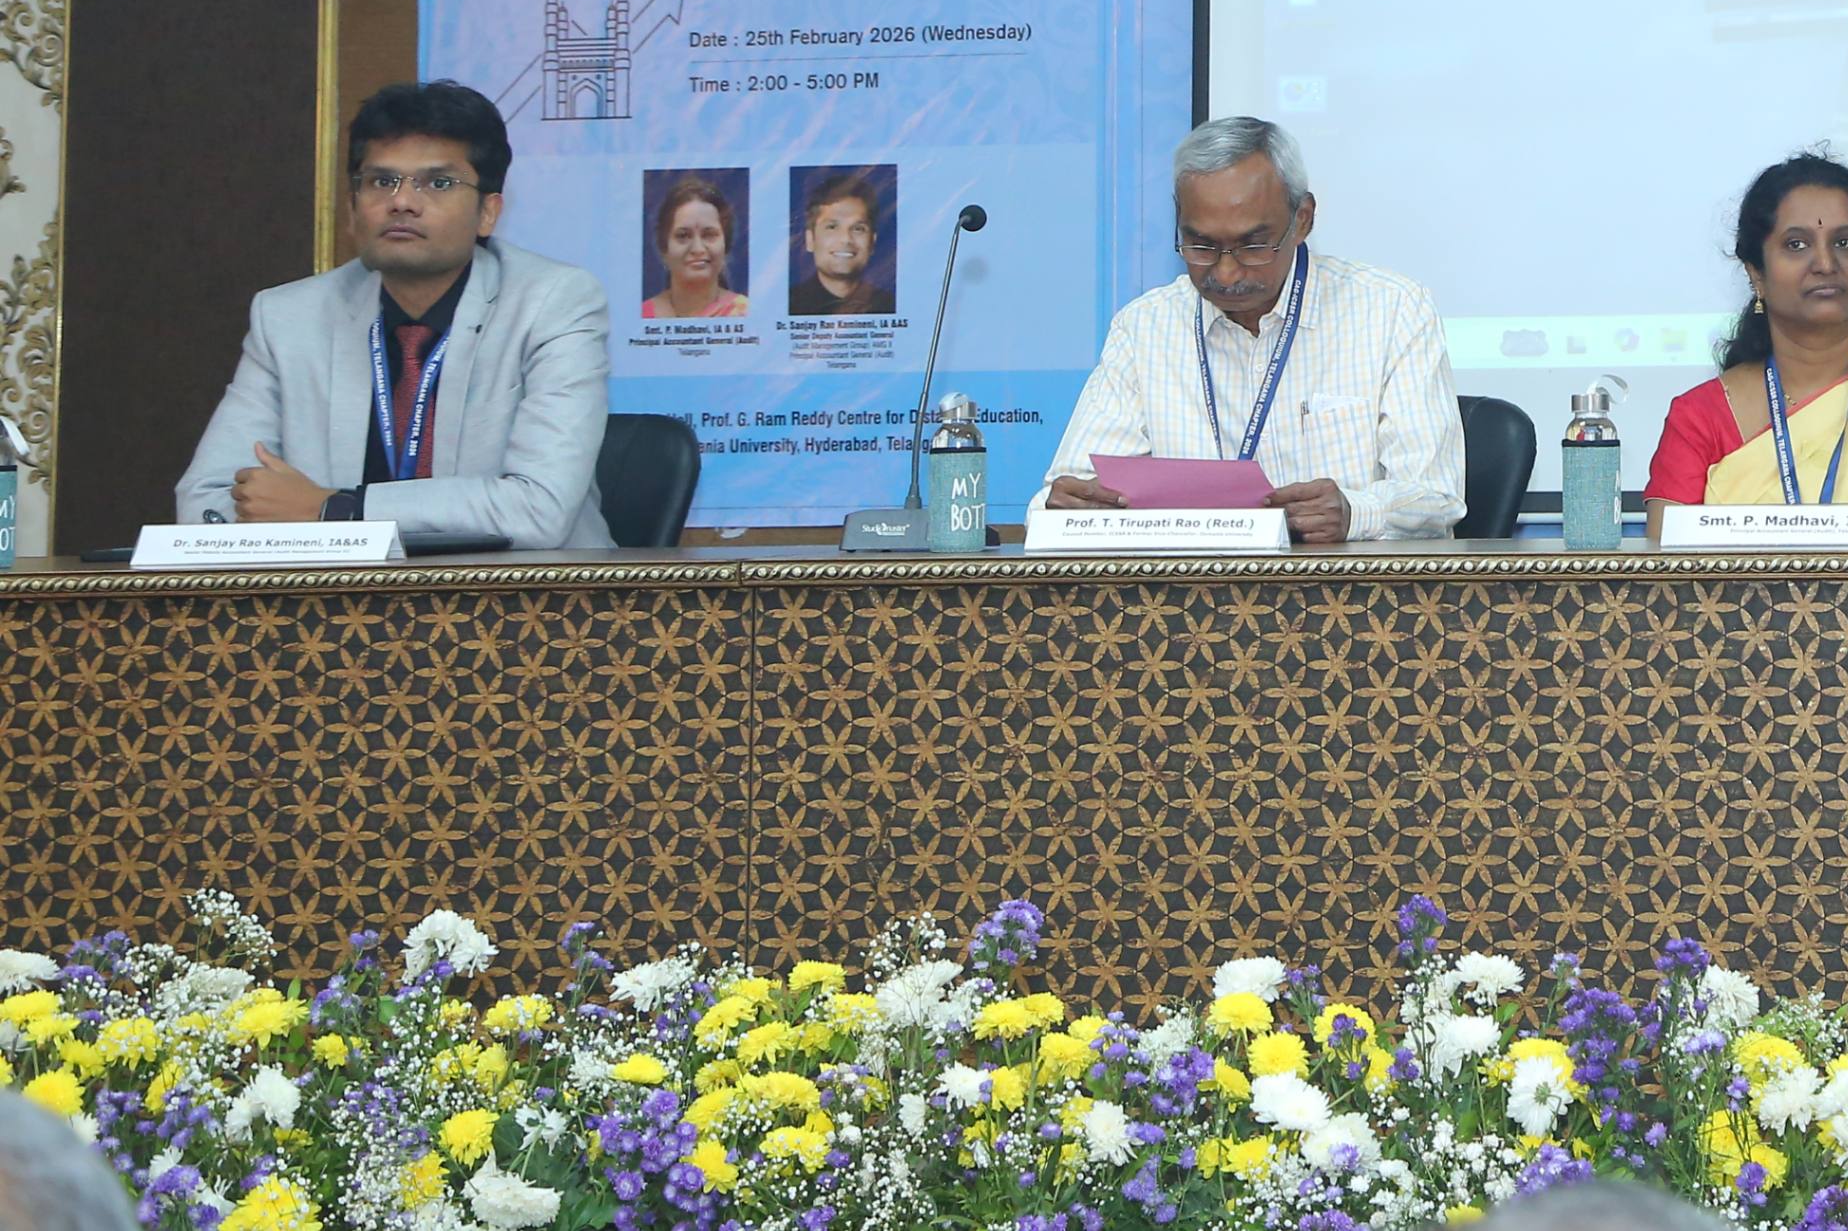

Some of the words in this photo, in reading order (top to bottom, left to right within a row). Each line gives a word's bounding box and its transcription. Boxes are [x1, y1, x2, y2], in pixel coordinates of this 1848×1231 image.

[690, 32, 727, 47] Date
[746, 30, 783, 46] 25th
[790, 29, 863, 46] February
[870, 27, 915, 43] 2026
[922, 23, 1031, 43] (Wednesday)
[689, 77, 730, 92] Time
[748, 75, 788, 91] 2:00
[807, 74, 847, 89] 5:00
[854, 72, 878, 88] PM
[1289, 279, 1302, 315] CAG-ICSSR
[1274, 315, 1294, 364] COLLOQUIUM,
[1259, 363, 1278, 403] TELANGANA
[702, 413, 732, 427] Prof.
[737, 412, 750, 427] G.
[755, 412, 786, 426] Ram
[791, 411, 833, 428] Reddy
[838, 410, 881, 425] Centre
[886, 410, 904, 424] for
[1249, 403, 1263, 438] CHAPTER,
[730, 438, 800, 455] University,
[805, 437, 881, 455] Hyderabad,
[1243, 438, 1252, 454] 2026
[952, 472, 981, 500] MY
[1066, 518, 1096, 528] Prof.
[1102, 518, 1113, 527] T.
[1119, 518, 1171, 529] Tirupati
[1175, 518, 1200, 528] Rao
[1206, 518, 1254, 530] (Retd.)
[1699, 515, 1736, 526] Smt.
[1743, 515, 1758, 526] P.
[1765, 515, 1839, 528] Madhavi,
[173, 539, 190, 547] Dr.
[194, 539, 236, 549] Sanjay
[239, 539, 262, 547] Rao
[265, 538, 324, 547] Kamineni,
[328, 538, 368, 547] IA&AS
